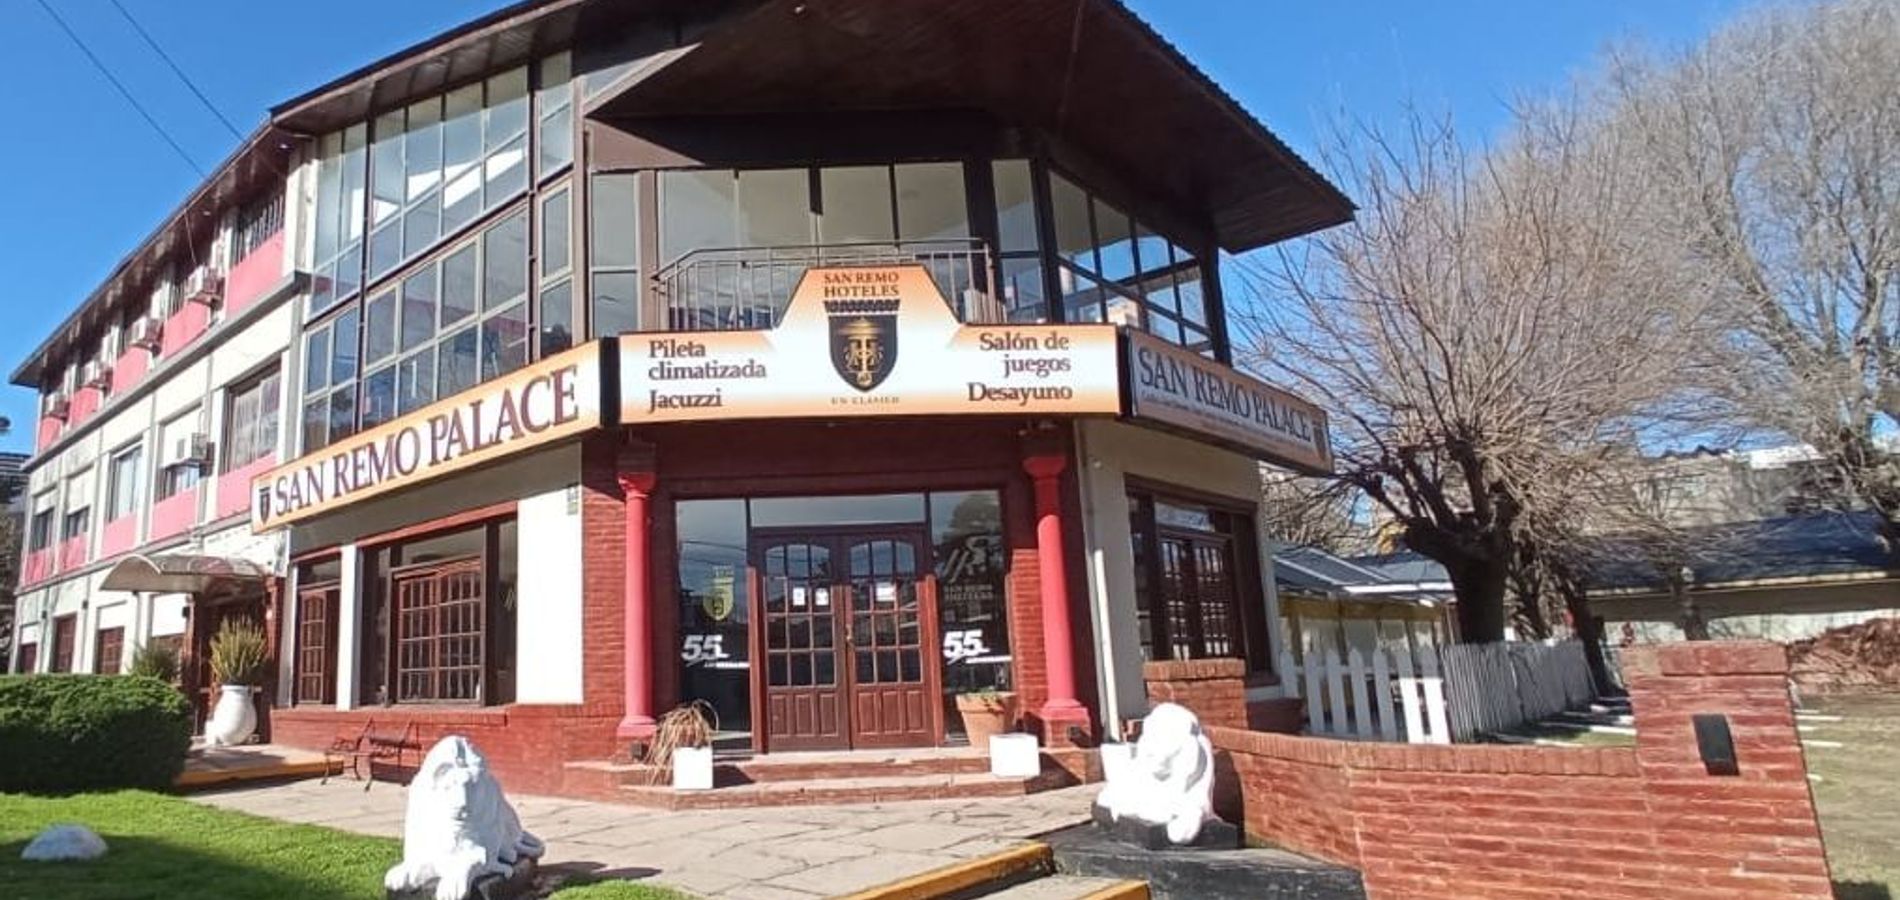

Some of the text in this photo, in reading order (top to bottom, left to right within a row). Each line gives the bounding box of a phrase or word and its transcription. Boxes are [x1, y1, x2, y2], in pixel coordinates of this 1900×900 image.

[824, 271, 900, 283] SAN REMO
[824, 284, 900, 297] HOTELES
[648, 338, 706, 358] Pileta
[979, 330, 1070, 351] Salón de
[648, 359, 767, 380] climatizada
[1004, 353, 1072, 378] juegos
[648, 387, 723, 414] Jacuzzi
[967, 381, 1073, 406] Desayuno
[1138, 347, 1189, 398] SAN
[1193, 366, 1250, 418] REMO
[1253, 389, 1311, 442] PALACE
[275, 363, 579, 518] SAN REMO PALACE
[681, 634, 723, 661] 55
[942, 628, 984, 660] 55
